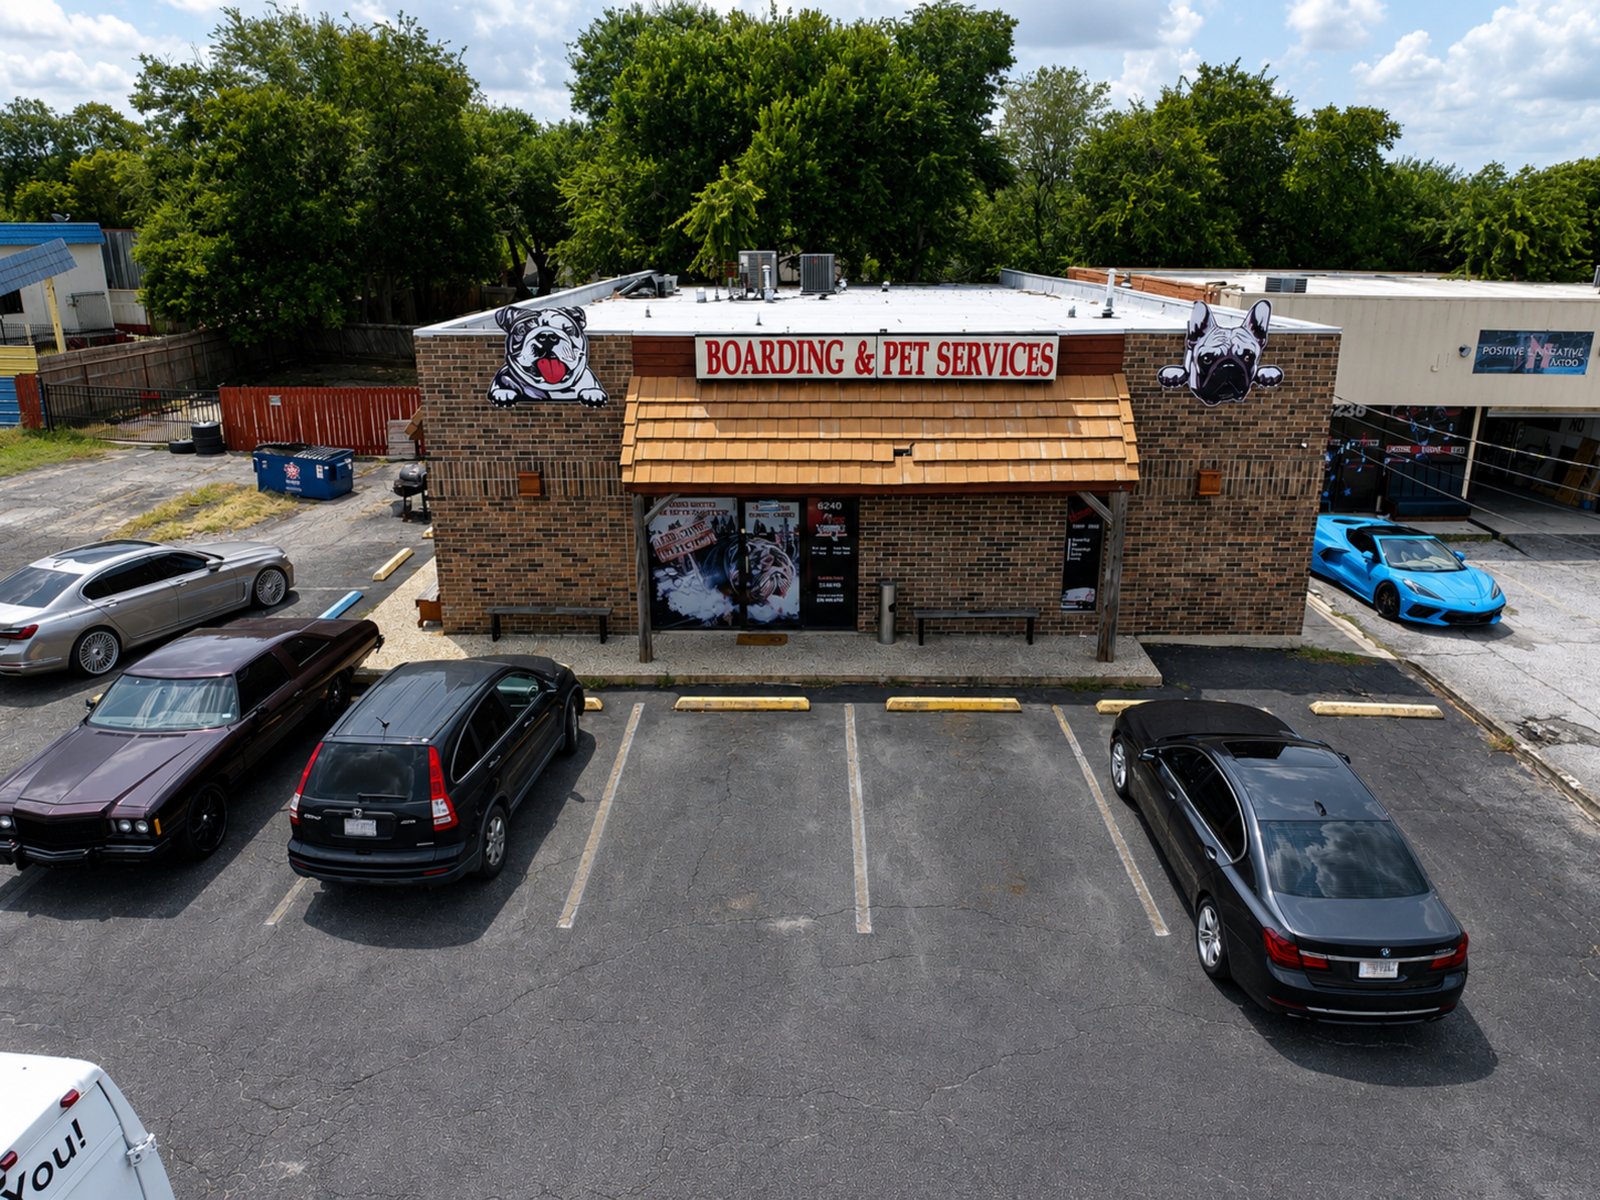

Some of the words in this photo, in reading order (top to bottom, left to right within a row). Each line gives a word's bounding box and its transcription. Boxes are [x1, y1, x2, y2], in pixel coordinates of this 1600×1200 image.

[705, 340, 844, 375] BOARDING
[855, 340, 875, 375] &
[883, 341, 929, 376] PET
[936, 342, 1055, 377] SERVICES
[1482, 346, 1524, 356] POSITIVE
[817, 502, 842, 511] 6240
[1, 1118, 87, 1200] You!
